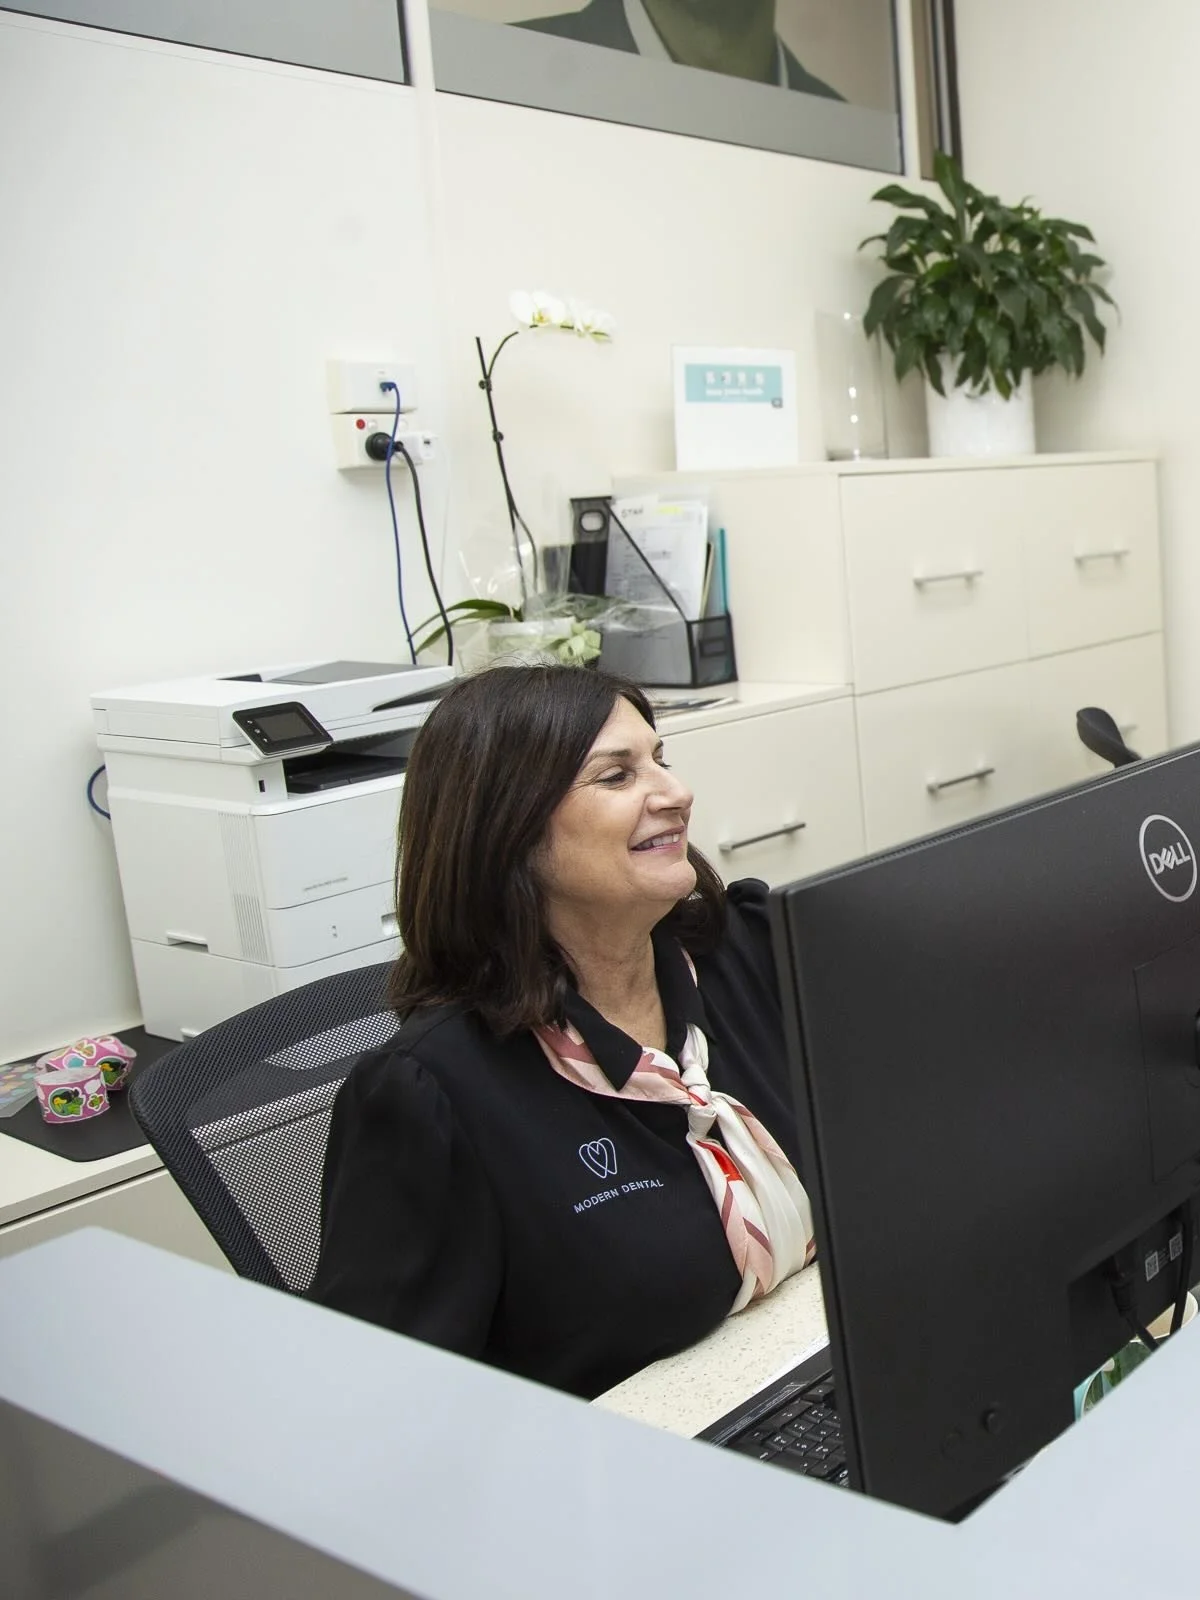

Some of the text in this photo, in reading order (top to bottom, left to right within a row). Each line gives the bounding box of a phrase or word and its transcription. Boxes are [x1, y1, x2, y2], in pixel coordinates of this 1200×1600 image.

[1148, 842, 1191, 875] DELL
[573, 1179, 664, 1213] MODERN DENTAL
